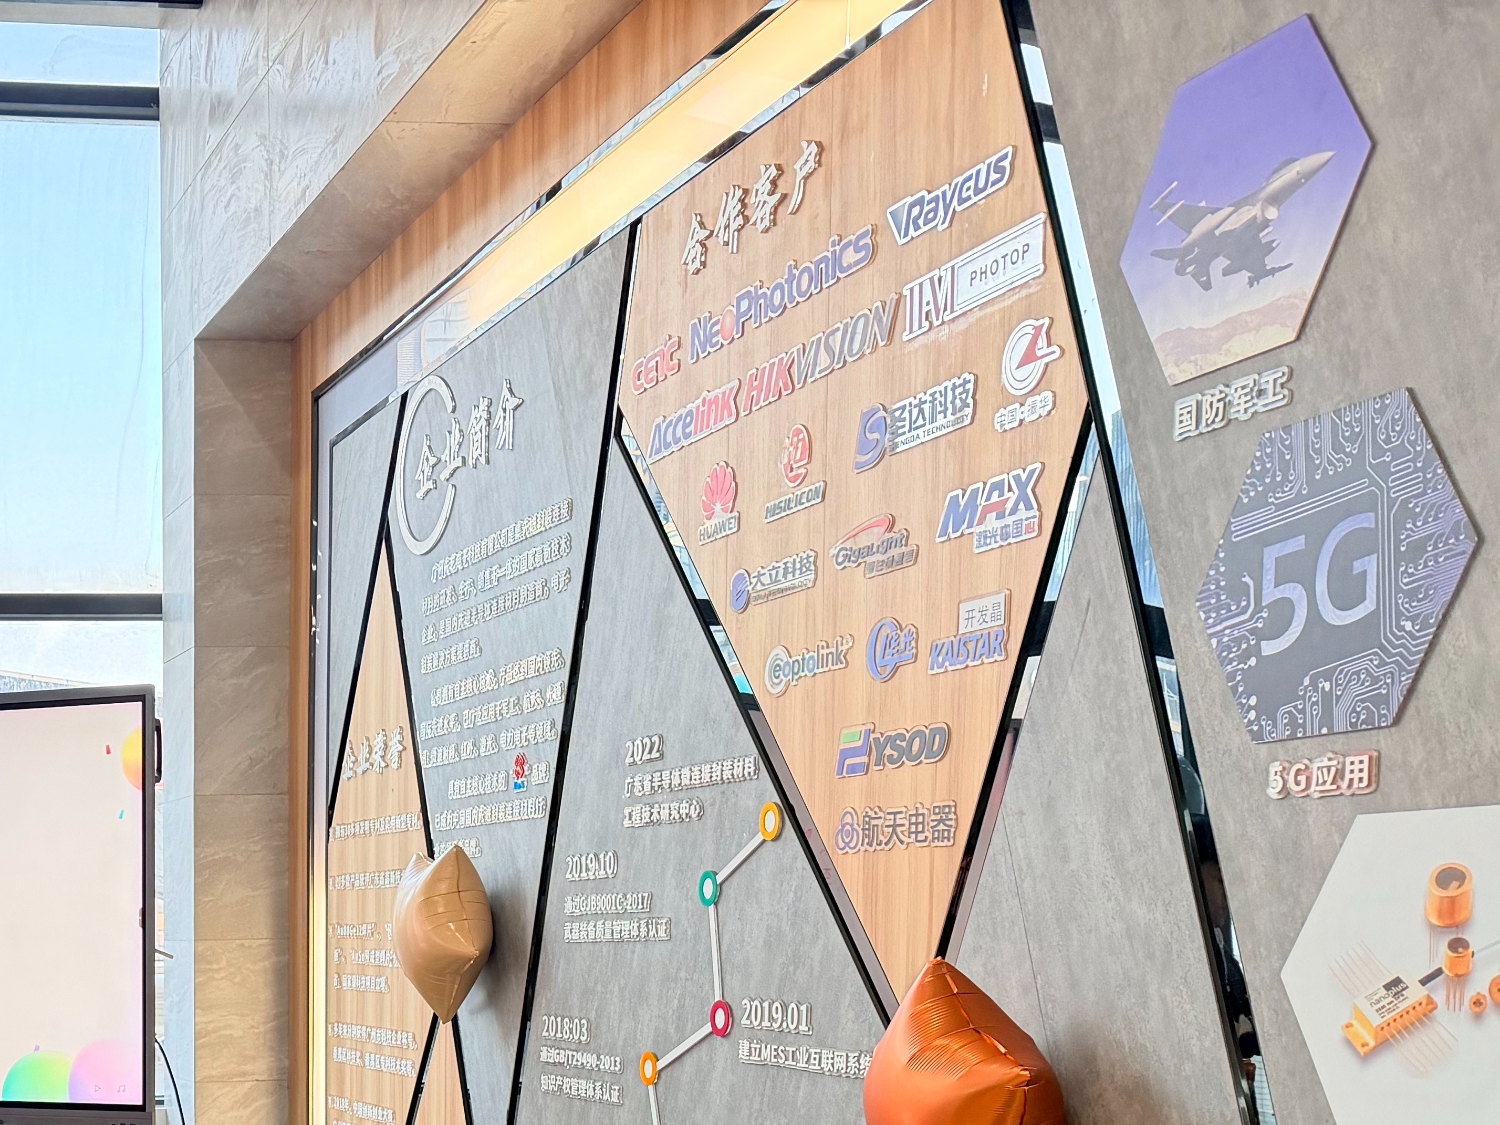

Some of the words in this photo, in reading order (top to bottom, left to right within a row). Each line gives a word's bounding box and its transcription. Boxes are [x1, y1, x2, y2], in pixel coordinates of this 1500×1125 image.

[902, 149, 1013, 241] Raycus
[969, 243, 1030, 287] PHOTOP
[689, 229, 873, 362] NeoPhotonics
[743, 297, 898, 410] HIKVISION
[650, 384, 737, 460] Accelink
[1175, 370, 1288, 438] 国防军工
[765, 484, 822, 520] HISILICON
[938, 468, 1038, 539] MAX
[699, 515, 737, 541] HUAWEI
[751, 552, 814, 591] 大立科技
[1260, 512, 1378, 656] 5G
[964, 598, 1003, 630] 开发晶
[930, 629, 1004, 673] KAISTAR
[625, 734, 663, 767] 2022
[1268, 753, 1371, 796] 5G应用
[861, 805, 957, 848] 航天电器
[566, 850, 618, 882] 2019.10
[541, 1015, 590, 1043] 2018.03
[740, 998, 812, 1035] 2019.01
